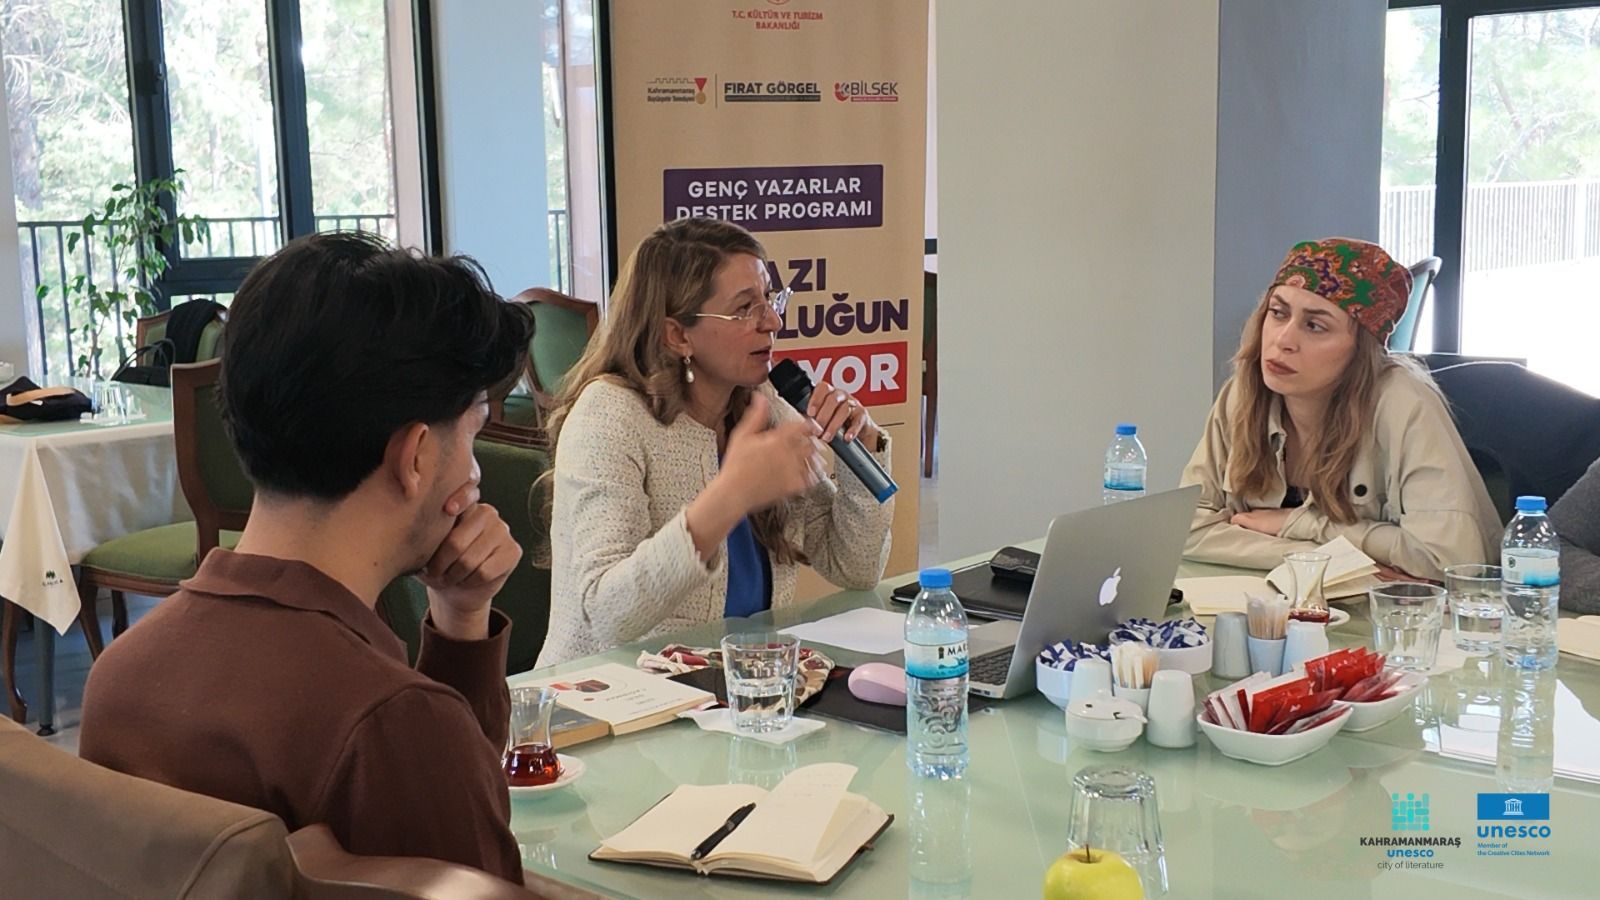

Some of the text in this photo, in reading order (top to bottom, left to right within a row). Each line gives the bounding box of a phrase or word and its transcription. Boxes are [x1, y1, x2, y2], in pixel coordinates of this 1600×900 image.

[781, 11, 792, 19] VE
[755, 21, 801, 30] BAKANLIĞI
[724, 80, 822, 94] FIRAT GÖRGEL
[850, 80, 899, 95] BİLSEK
[688, 177, 861, 200] GENÇ YAZARLAR
[676, 201, 872, 221] DESTEK PROGRAMI
